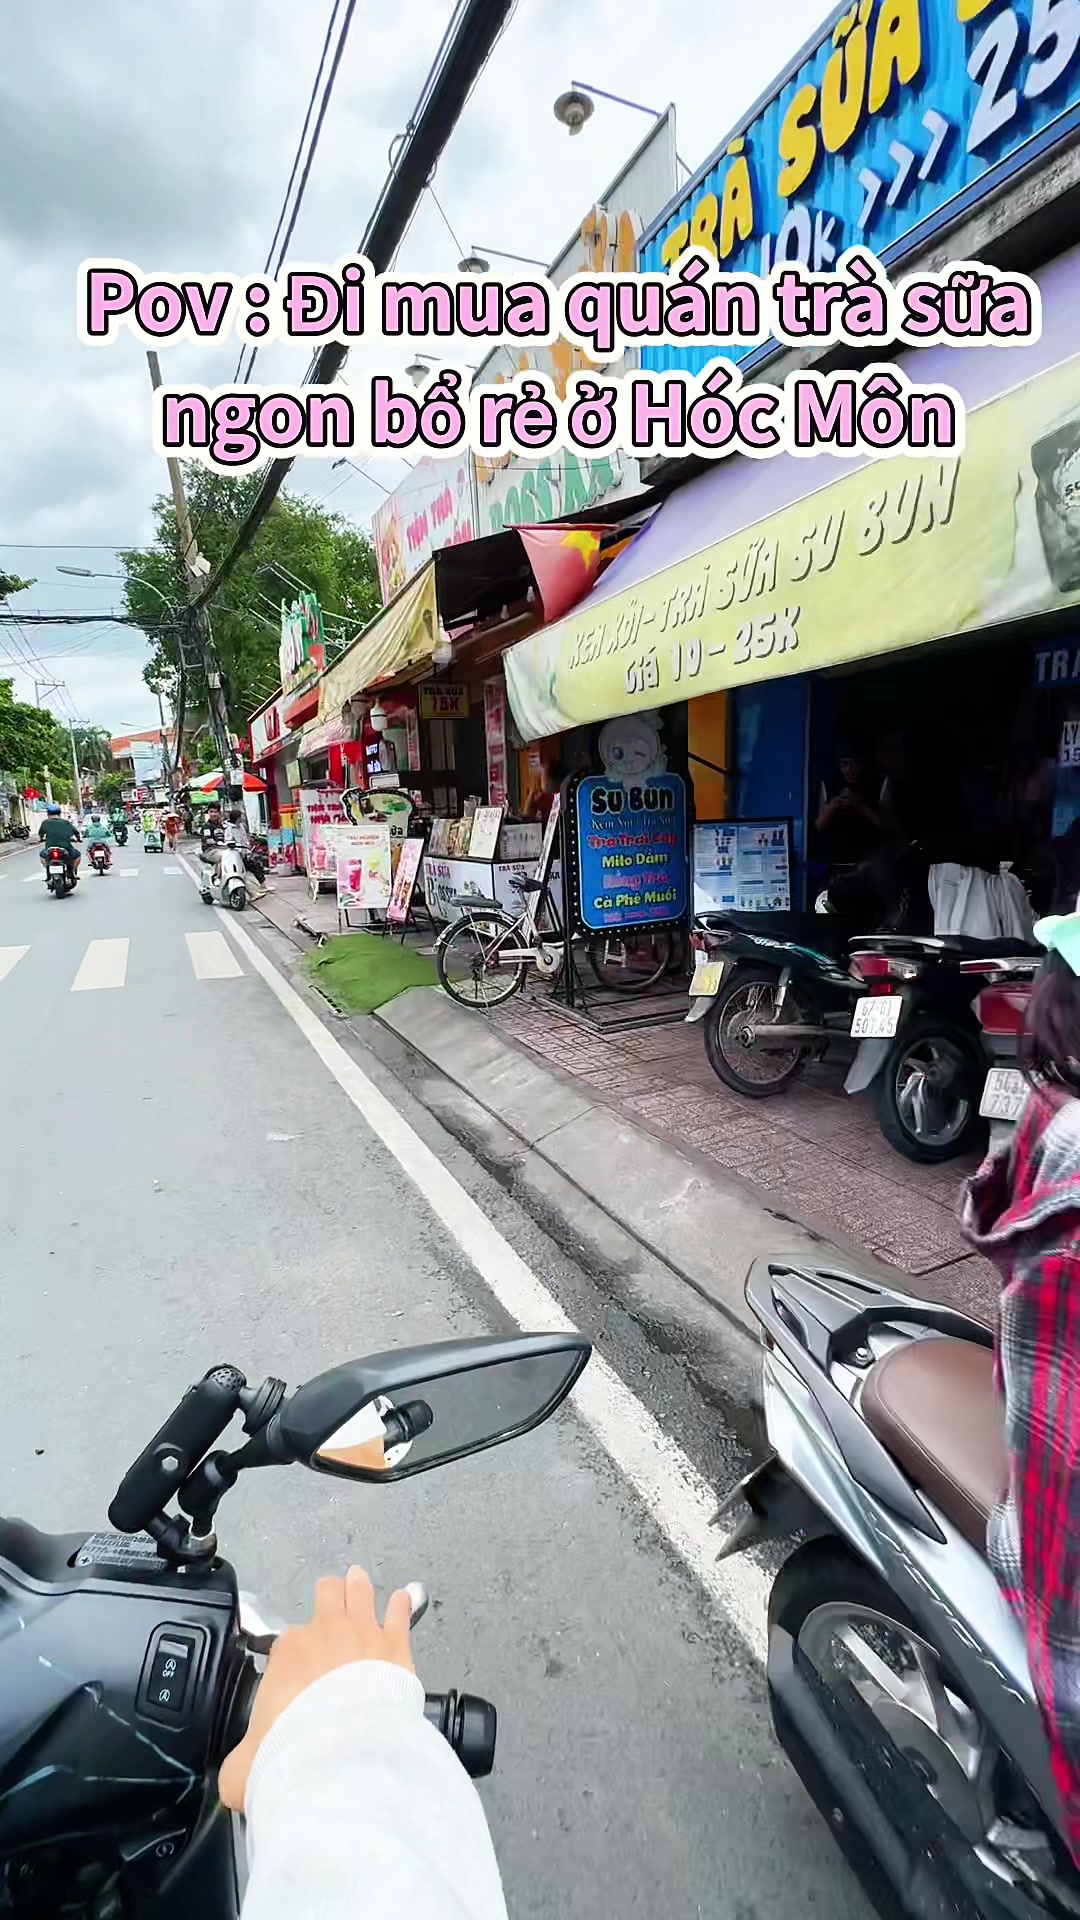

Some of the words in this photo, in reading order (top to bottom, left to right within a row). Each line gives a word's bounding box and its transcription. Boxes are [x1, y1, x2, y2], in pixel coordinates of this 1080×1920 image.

[857, 456, 962, 557] BUN
[733, 606, 802, 666] 25K
[602, 853, 633, 869] Milo
